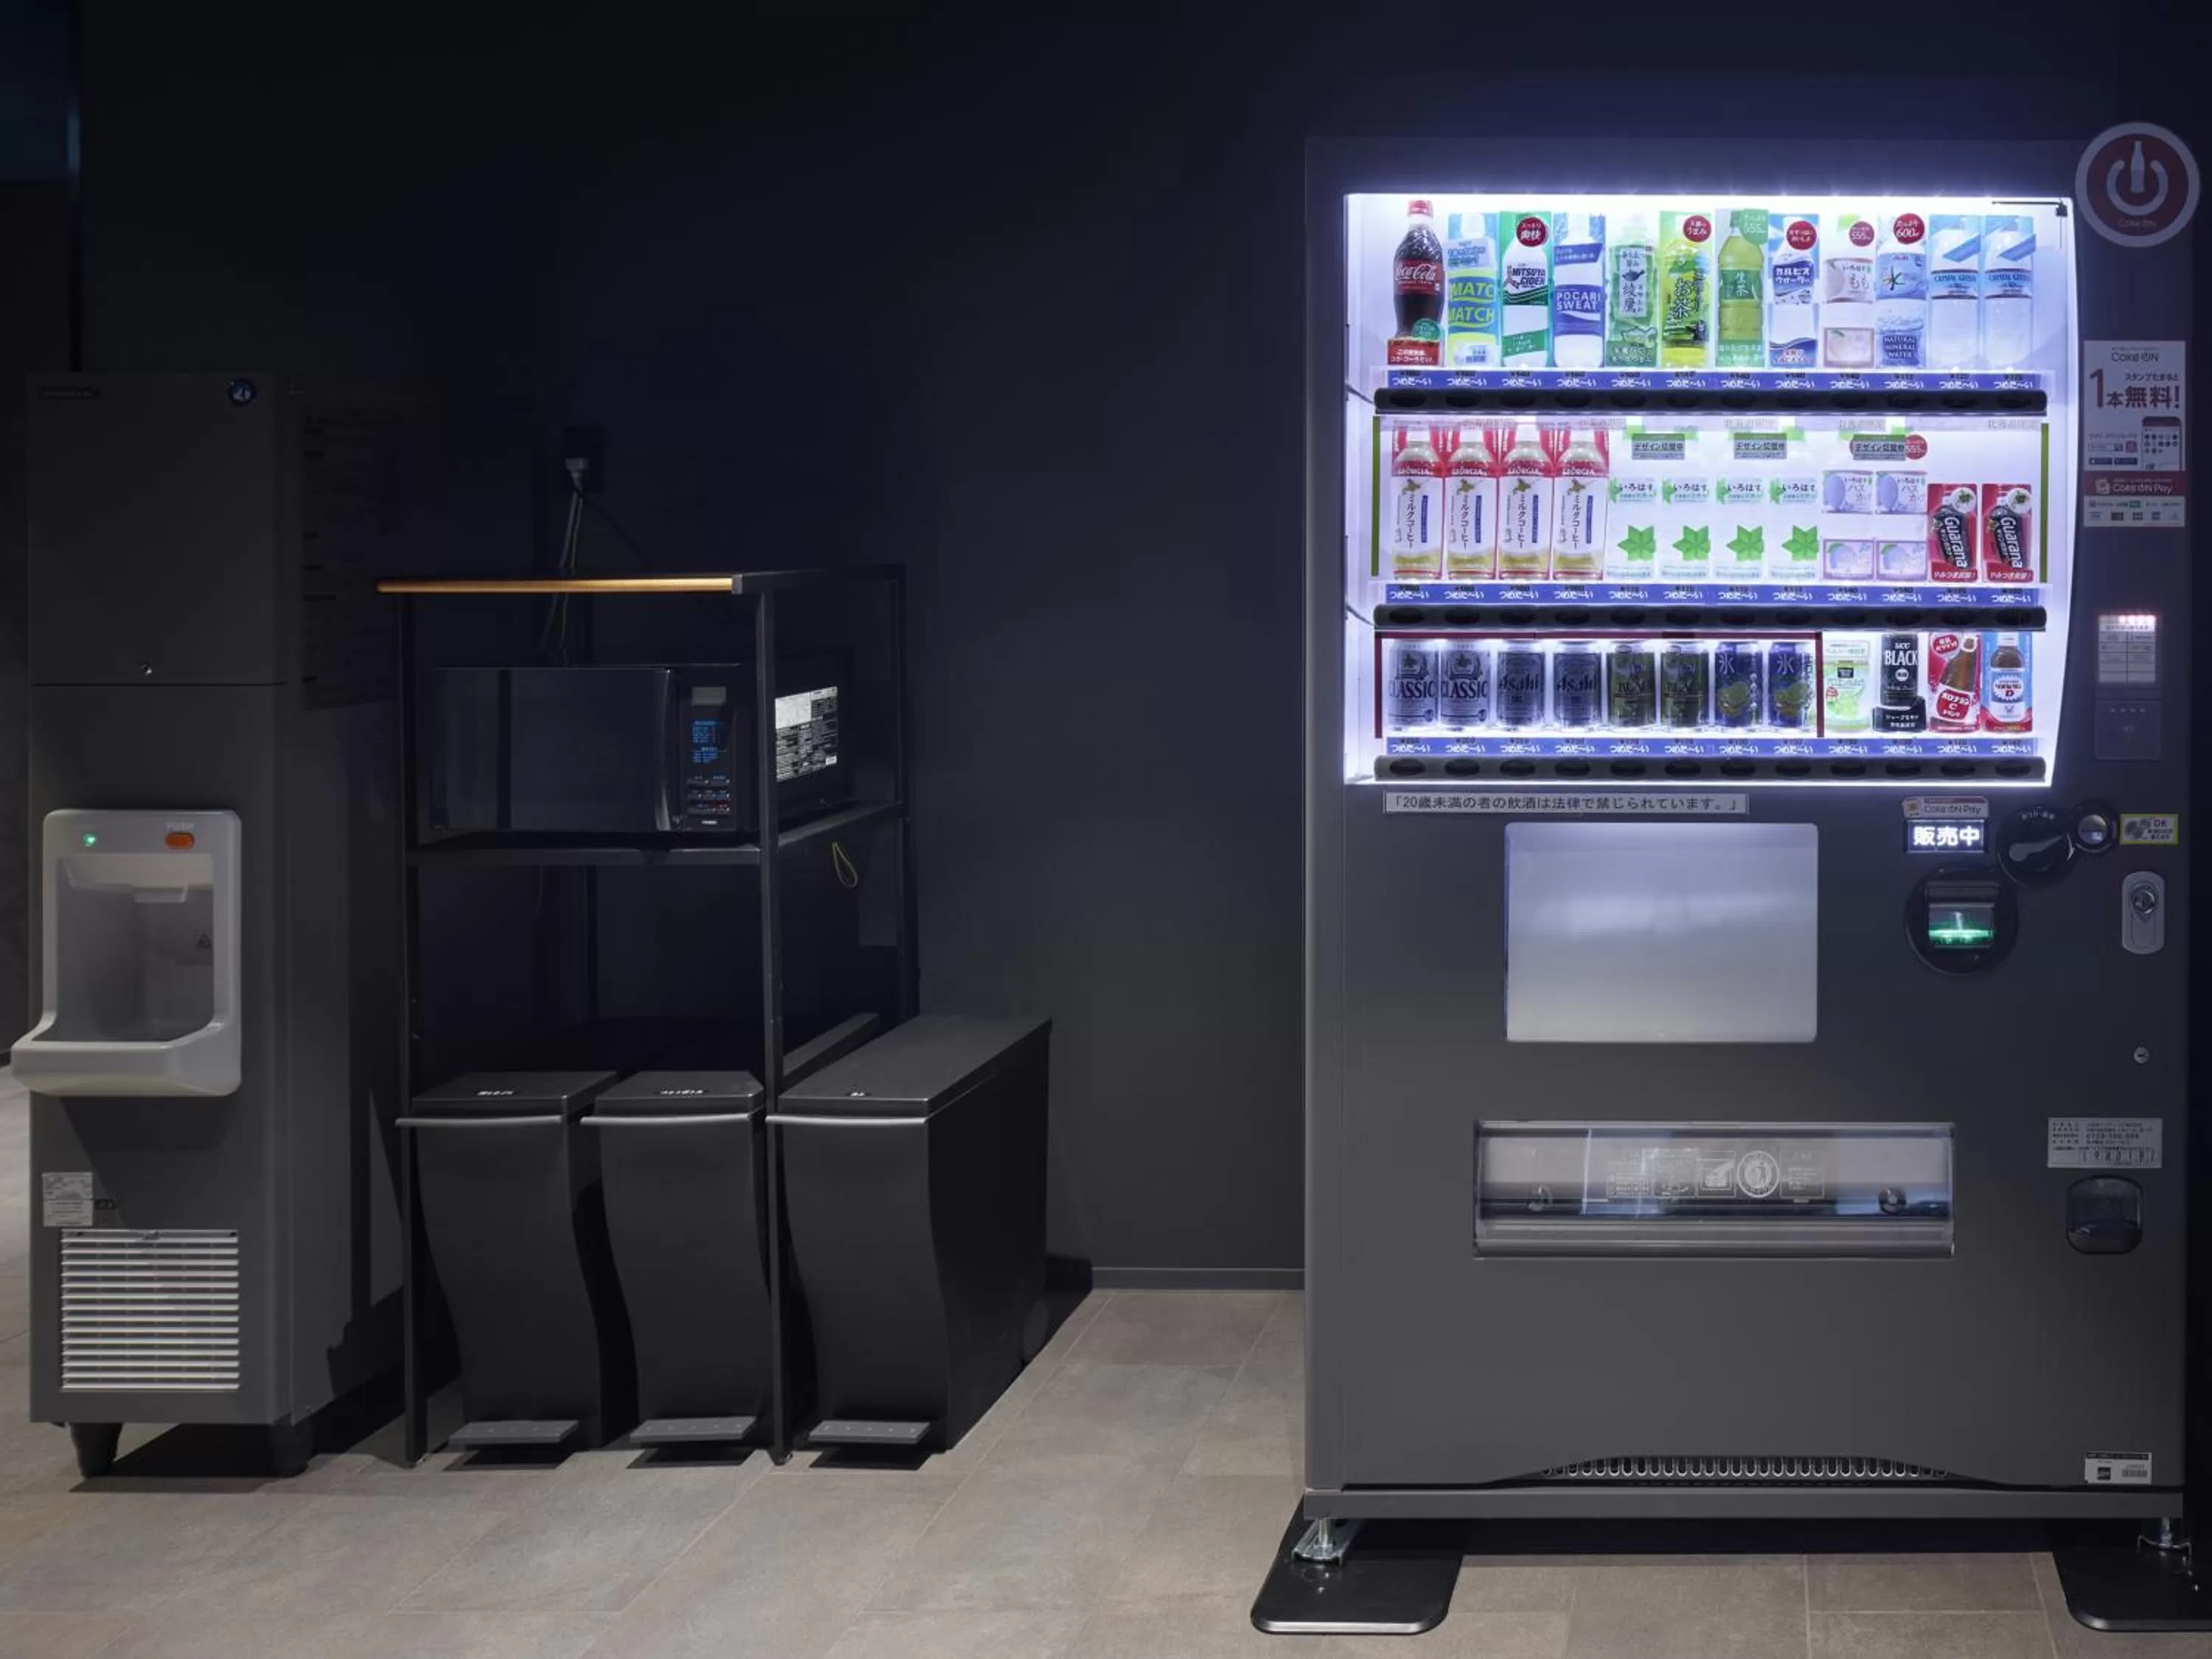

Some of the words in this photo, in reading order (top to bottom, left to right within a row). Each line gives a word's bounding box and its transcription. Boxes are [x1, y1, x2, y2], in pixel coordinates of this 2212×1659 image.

[1557, 301, 1598, 310] SWEAT
[2124, 372, 2180, 382] スタンプたまると
[1944, 517, 1970, 568] Guarana
[2000, 517, 2023, 568] Guarana
[1885, 650, 1919, 667] BLACK
[1390, 680, 1436, 699] CLASSIC
[1440, 680, 1488, 699] CLASSIC
[1499, 673, 1539, 692] Asahi
[1556, 673, 1596, 692] Asahi
[1396, 796, 1736, 811] 「20歳未満の者の飲酒は法律で禁じられています。」
[1913, 827, 1980, 847] 販売中
